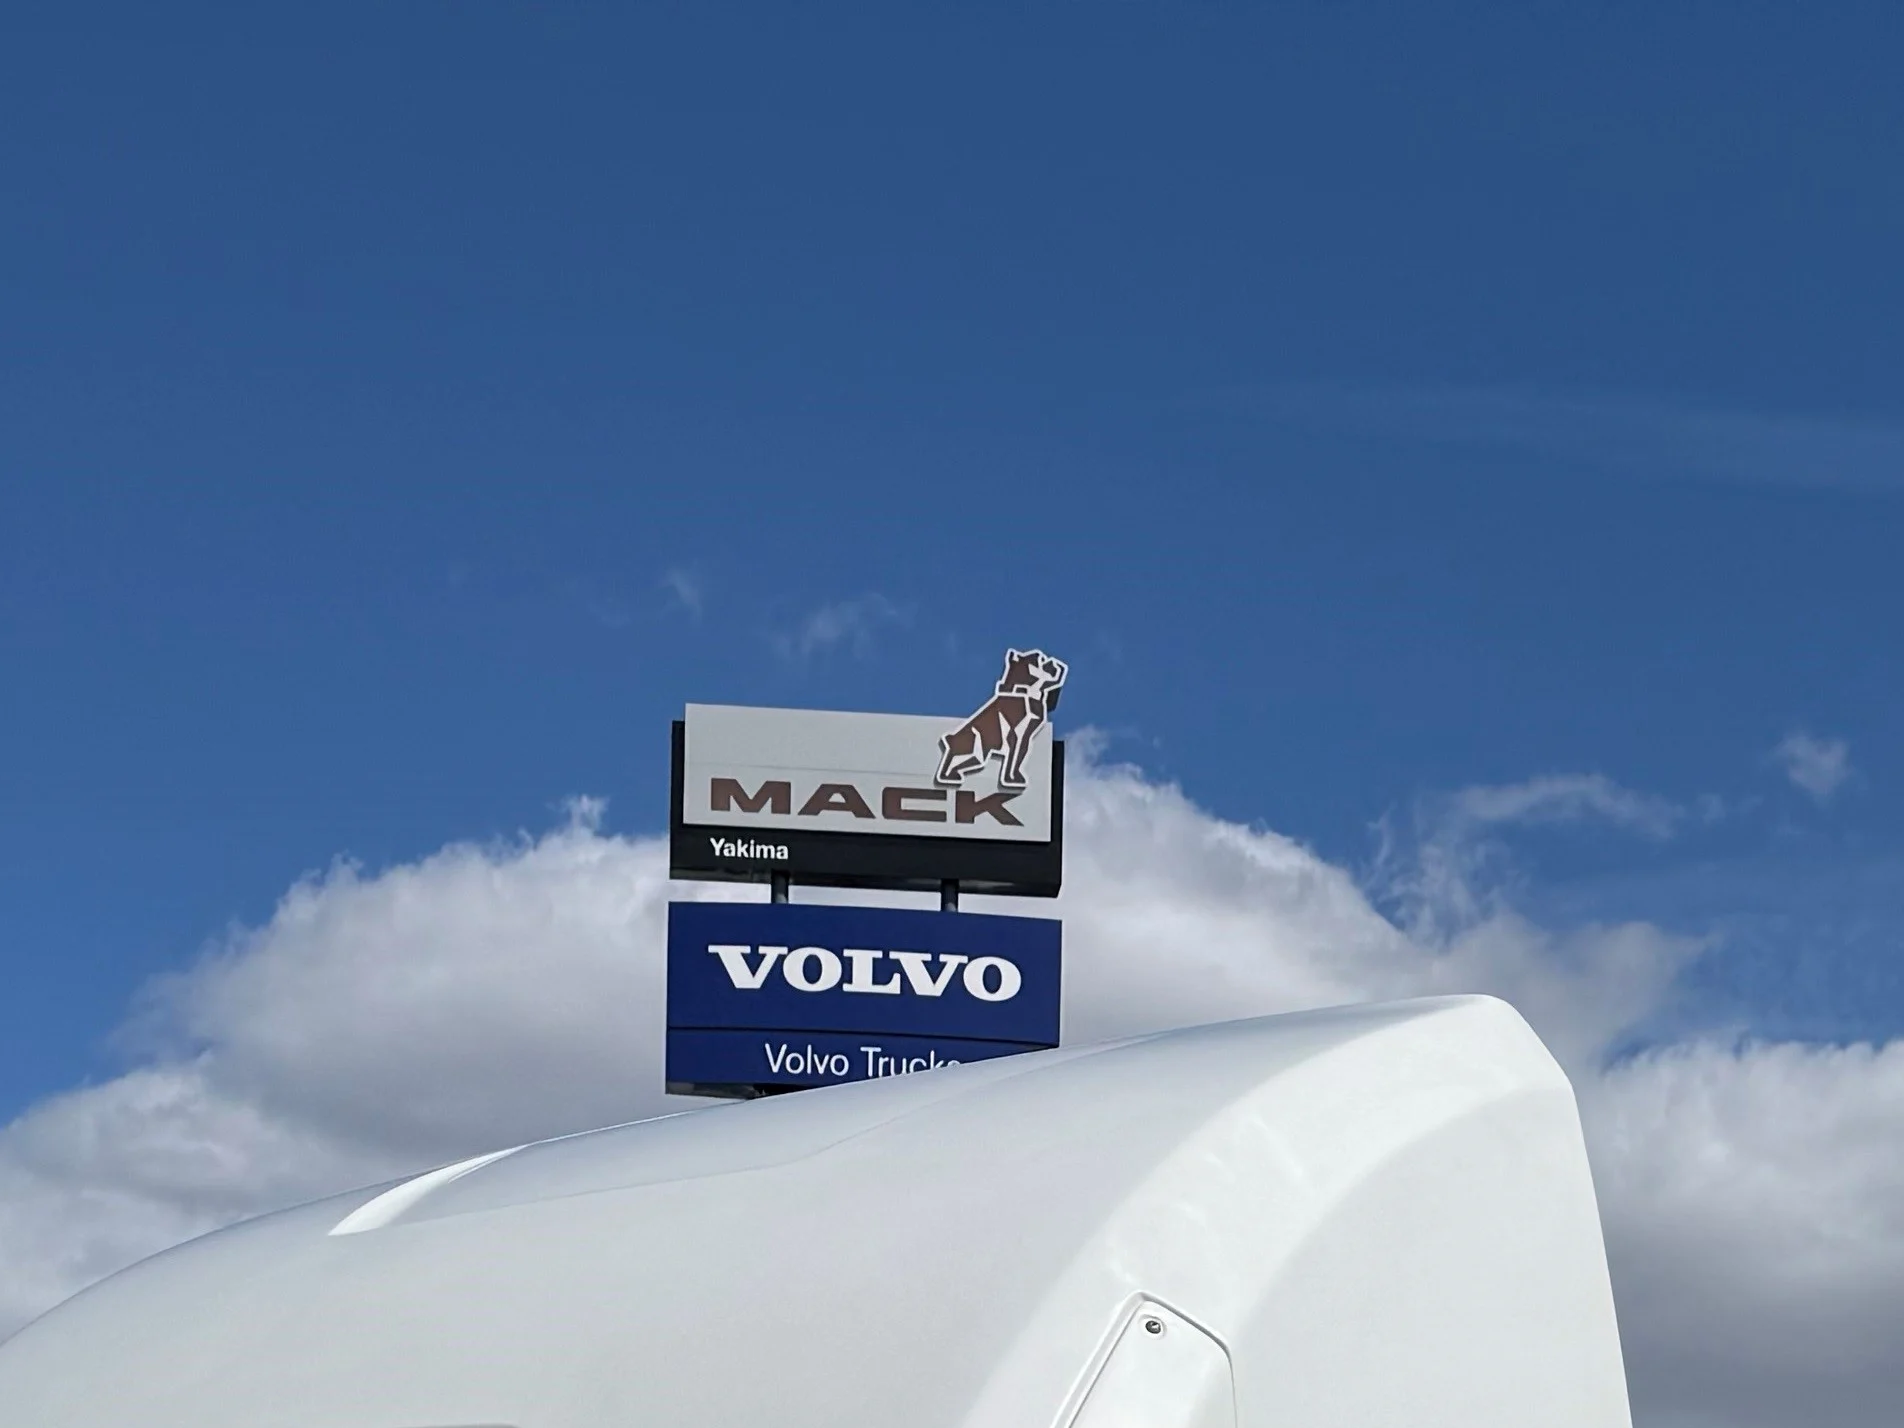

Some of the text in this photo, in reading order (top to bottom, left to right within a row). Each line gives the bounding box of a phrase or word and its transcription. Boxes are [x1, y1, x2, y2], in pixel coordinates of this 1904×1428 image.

[710, 777, 1025, 828] MACK
[709, 837, 789, 860] Yakima
[707, 945, 1022, 1002] VOLVO
[764, 1043, 849, 1076] Volvo
